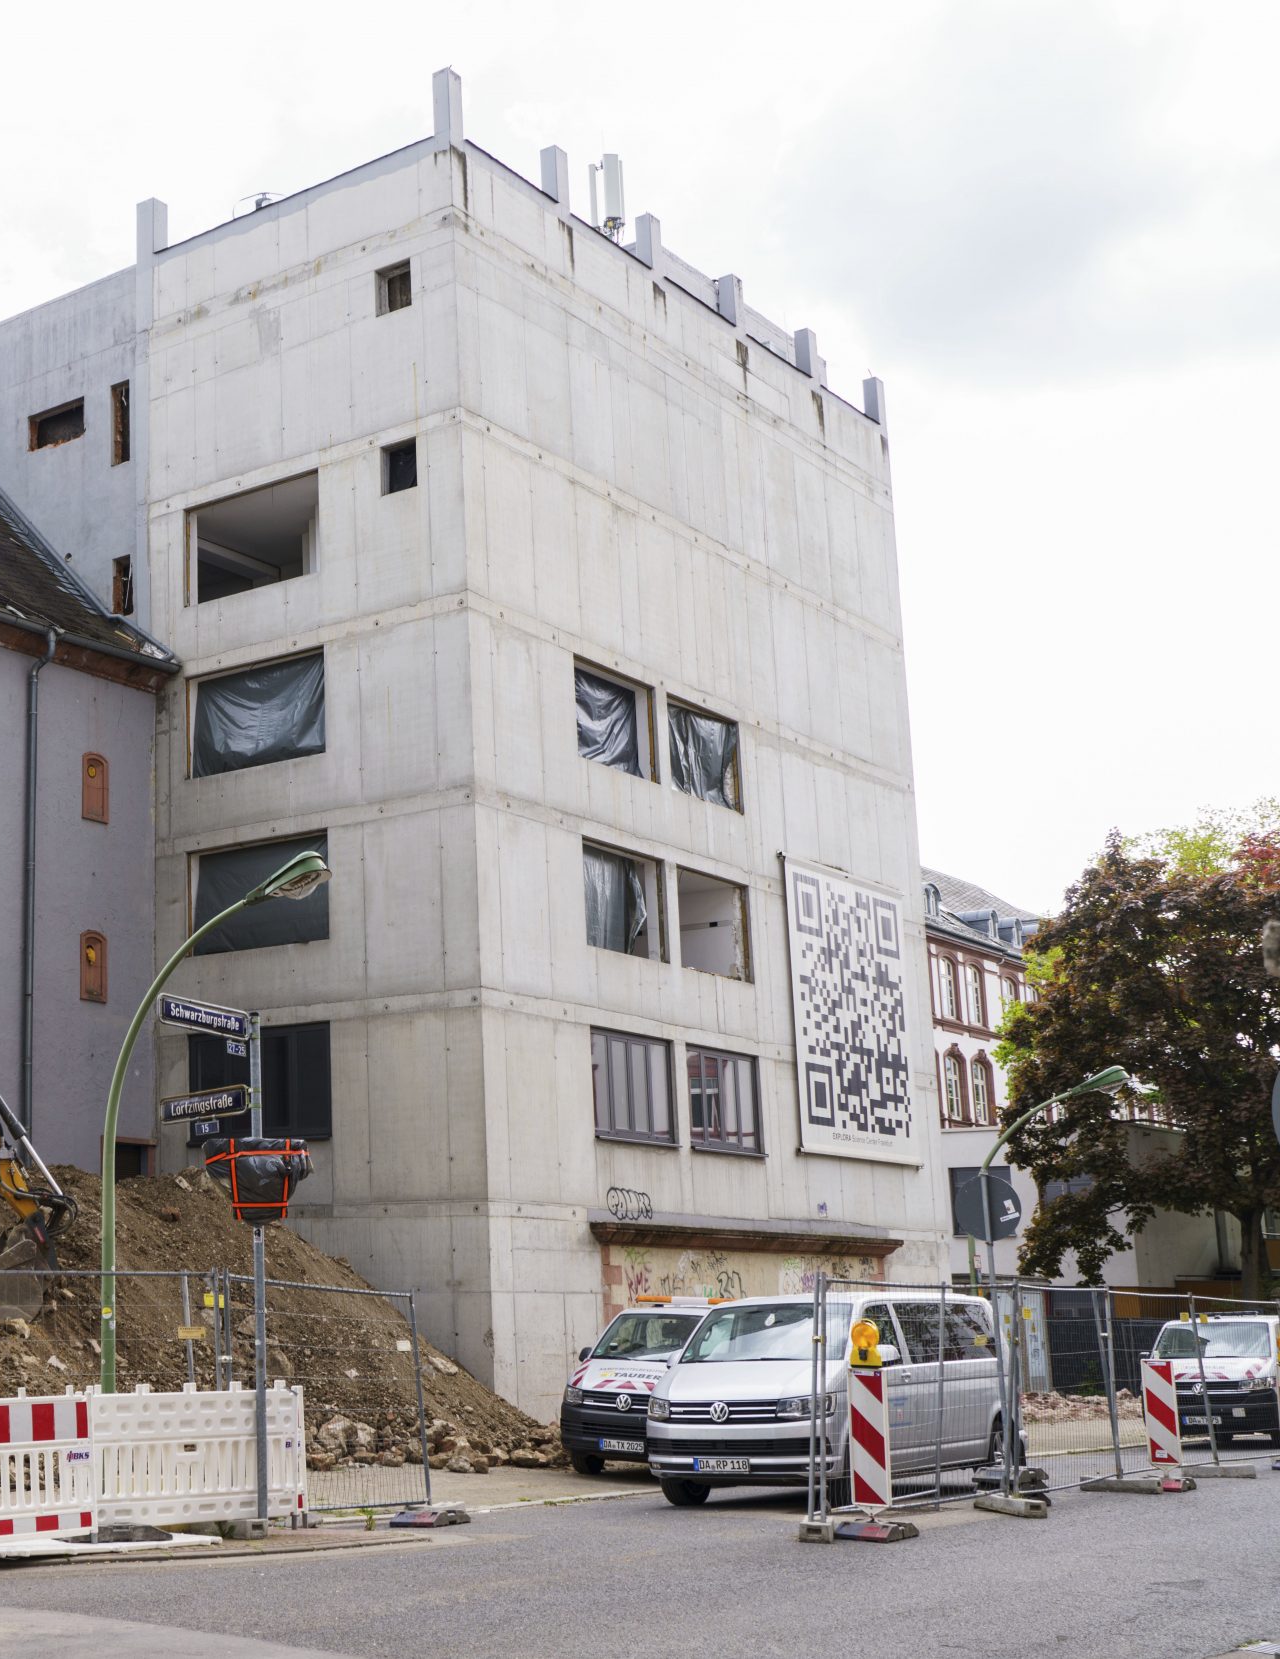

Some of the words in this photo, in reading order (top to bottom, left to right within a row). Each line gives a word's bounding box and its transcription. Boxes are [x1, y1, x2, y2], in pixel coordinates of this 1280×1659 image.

[170, 1003, 239, 1031] Schwarzburgstraße
[171, 1094, 233, 1116] Lortzingstraße
[201, 1124, 209, 1133] 15
[614, 1372, 662, 1380] TAUBER
[604, 1441, 611, 1449] DA
[617, 1441, 625, 1450] TX
[627, 1442, 643, 1451] 2025
[73, 1451, 90, 1460] BKS
[699, 1460, 711, 1470] DA
[716, 1460, 728, 1470] RP
[730, 1460, 748, 1470] 118
